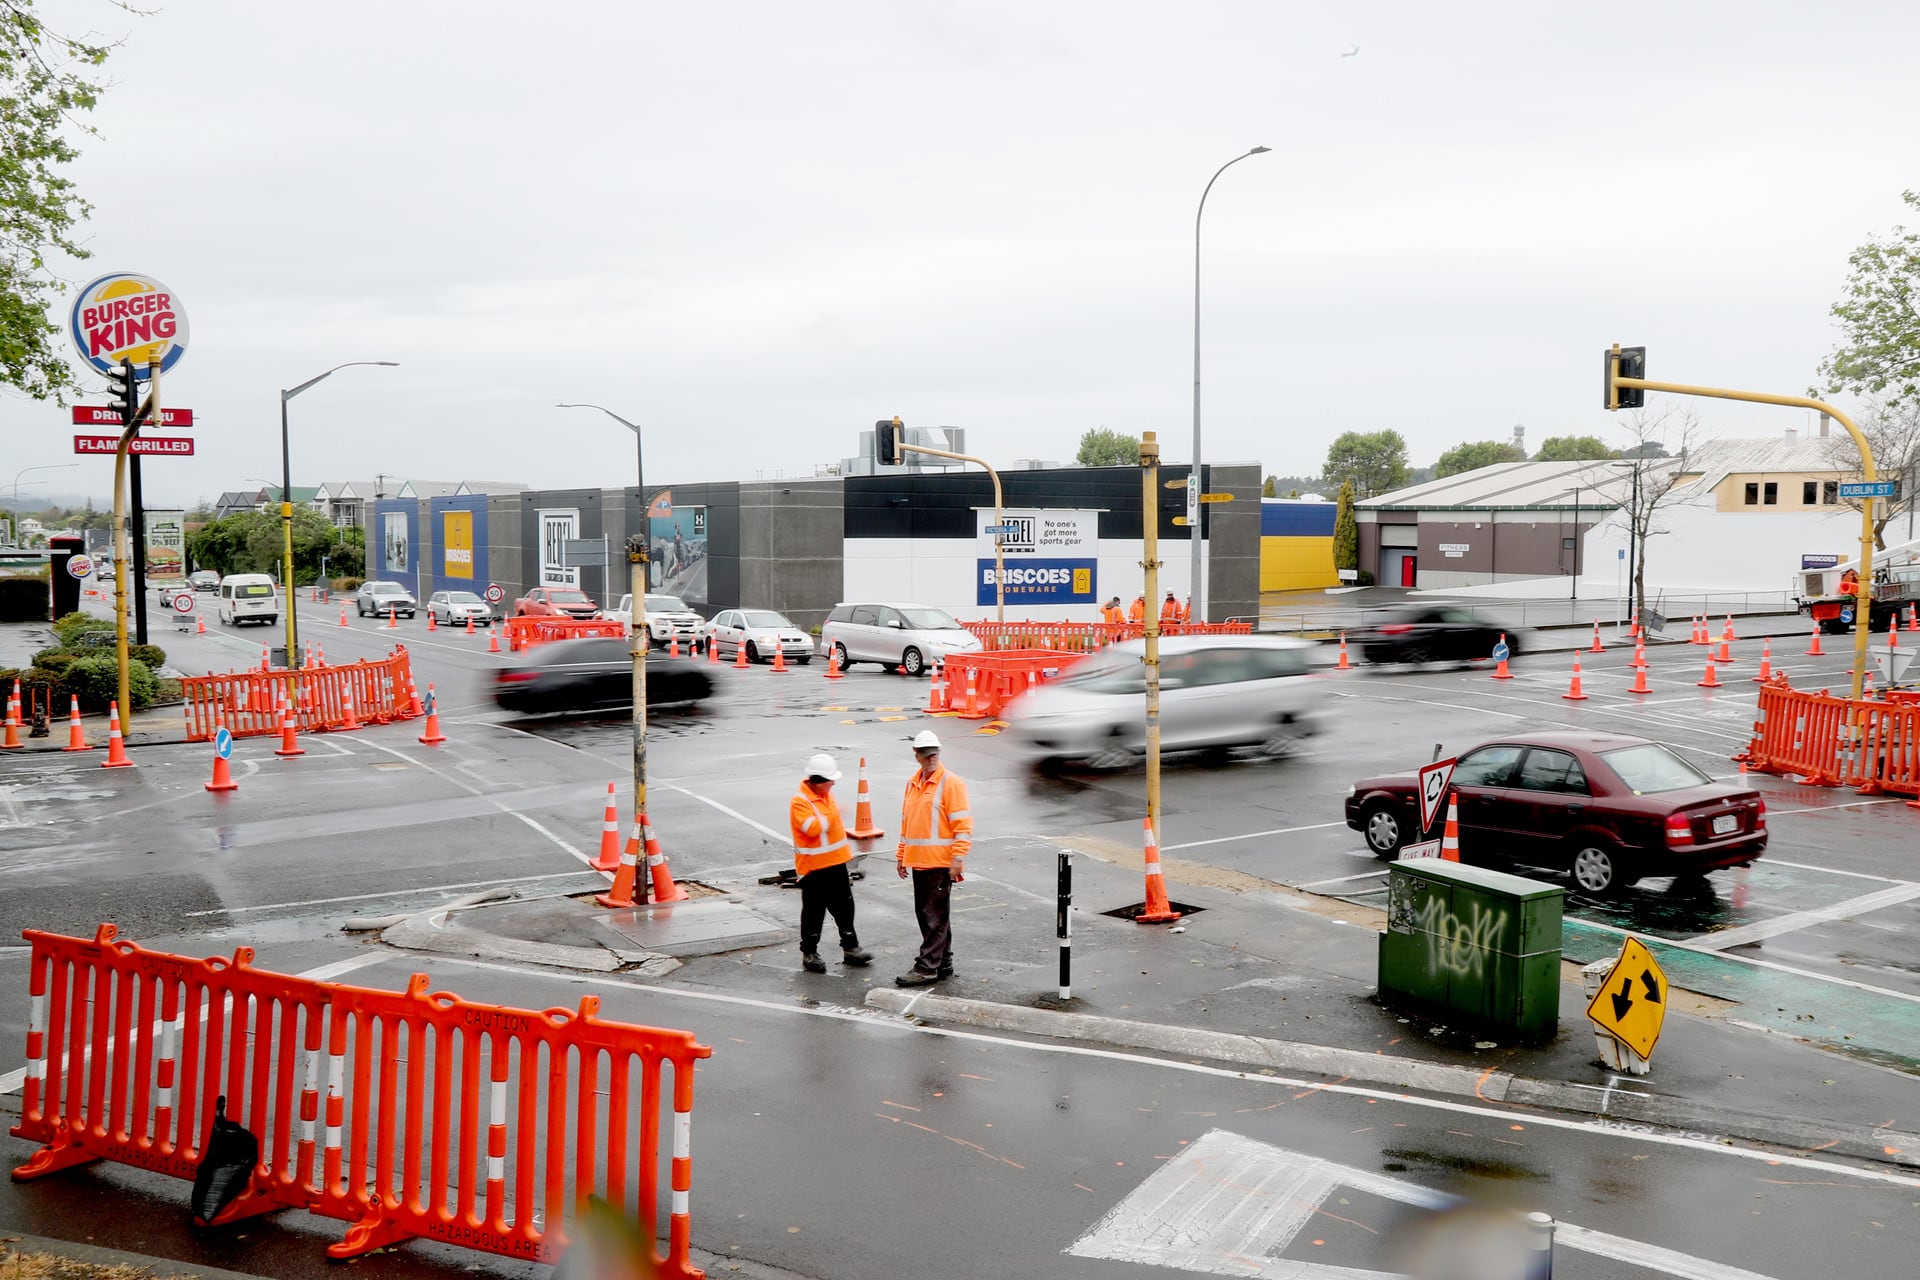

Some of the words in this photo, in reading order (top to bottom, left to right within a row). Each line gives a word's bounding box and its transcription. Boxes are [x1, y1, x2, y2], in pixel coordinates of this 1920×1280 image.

[83, 293, 171, 330] BURGER
[89, 311, 177, 357] KING
[79, 440, 119, 450] FLAM
[131, 440, 190, 451] GRILLED
[1843, 485, 1873, 494] DUBLIN
[1877, 484, 1889, 493] ST
[1056, 520, 1077, 528] one's
[1043, 529, 1057, 537] got
[490, 590, 499, 598] 50
[178, 599, 189, 607] 50
[465, 1009, 529, 1033] CAUTION
[429, 1220, 509, 1251] HAZARDOUS
[513, 1239, 551, 1259] AREA
